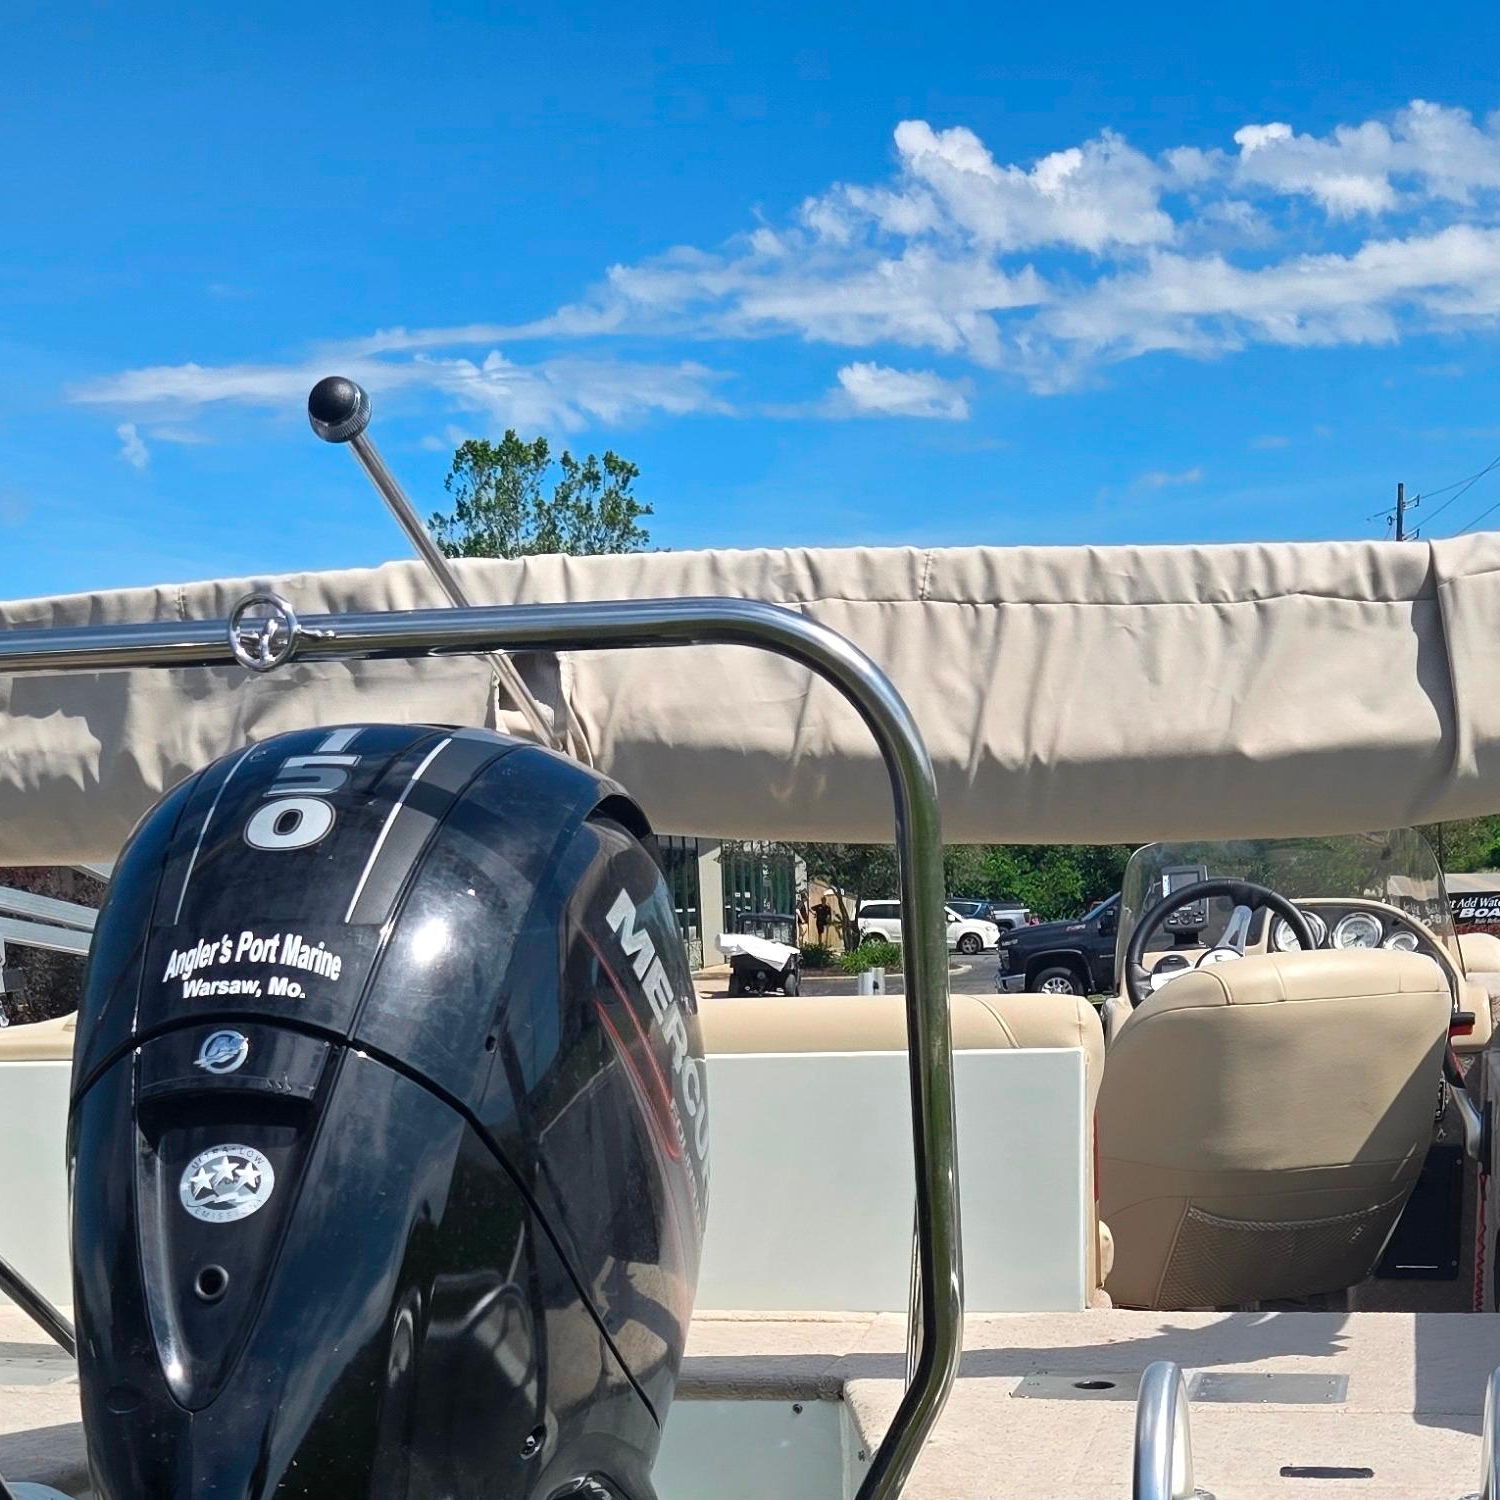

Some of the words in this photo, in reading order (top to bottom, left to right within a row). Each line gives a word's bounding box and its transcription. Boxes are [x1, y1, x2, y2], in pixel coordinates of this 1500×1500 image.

[1457, 897, 1478, 908] Add
[162, 934, 234, 983] Angler's
[234, 931, 281, 963] Port
[280, 933, 342, 981] Marine
[182, 978, 262, 999] Warsaw,
[267, 976, 306, 999] Mo.
